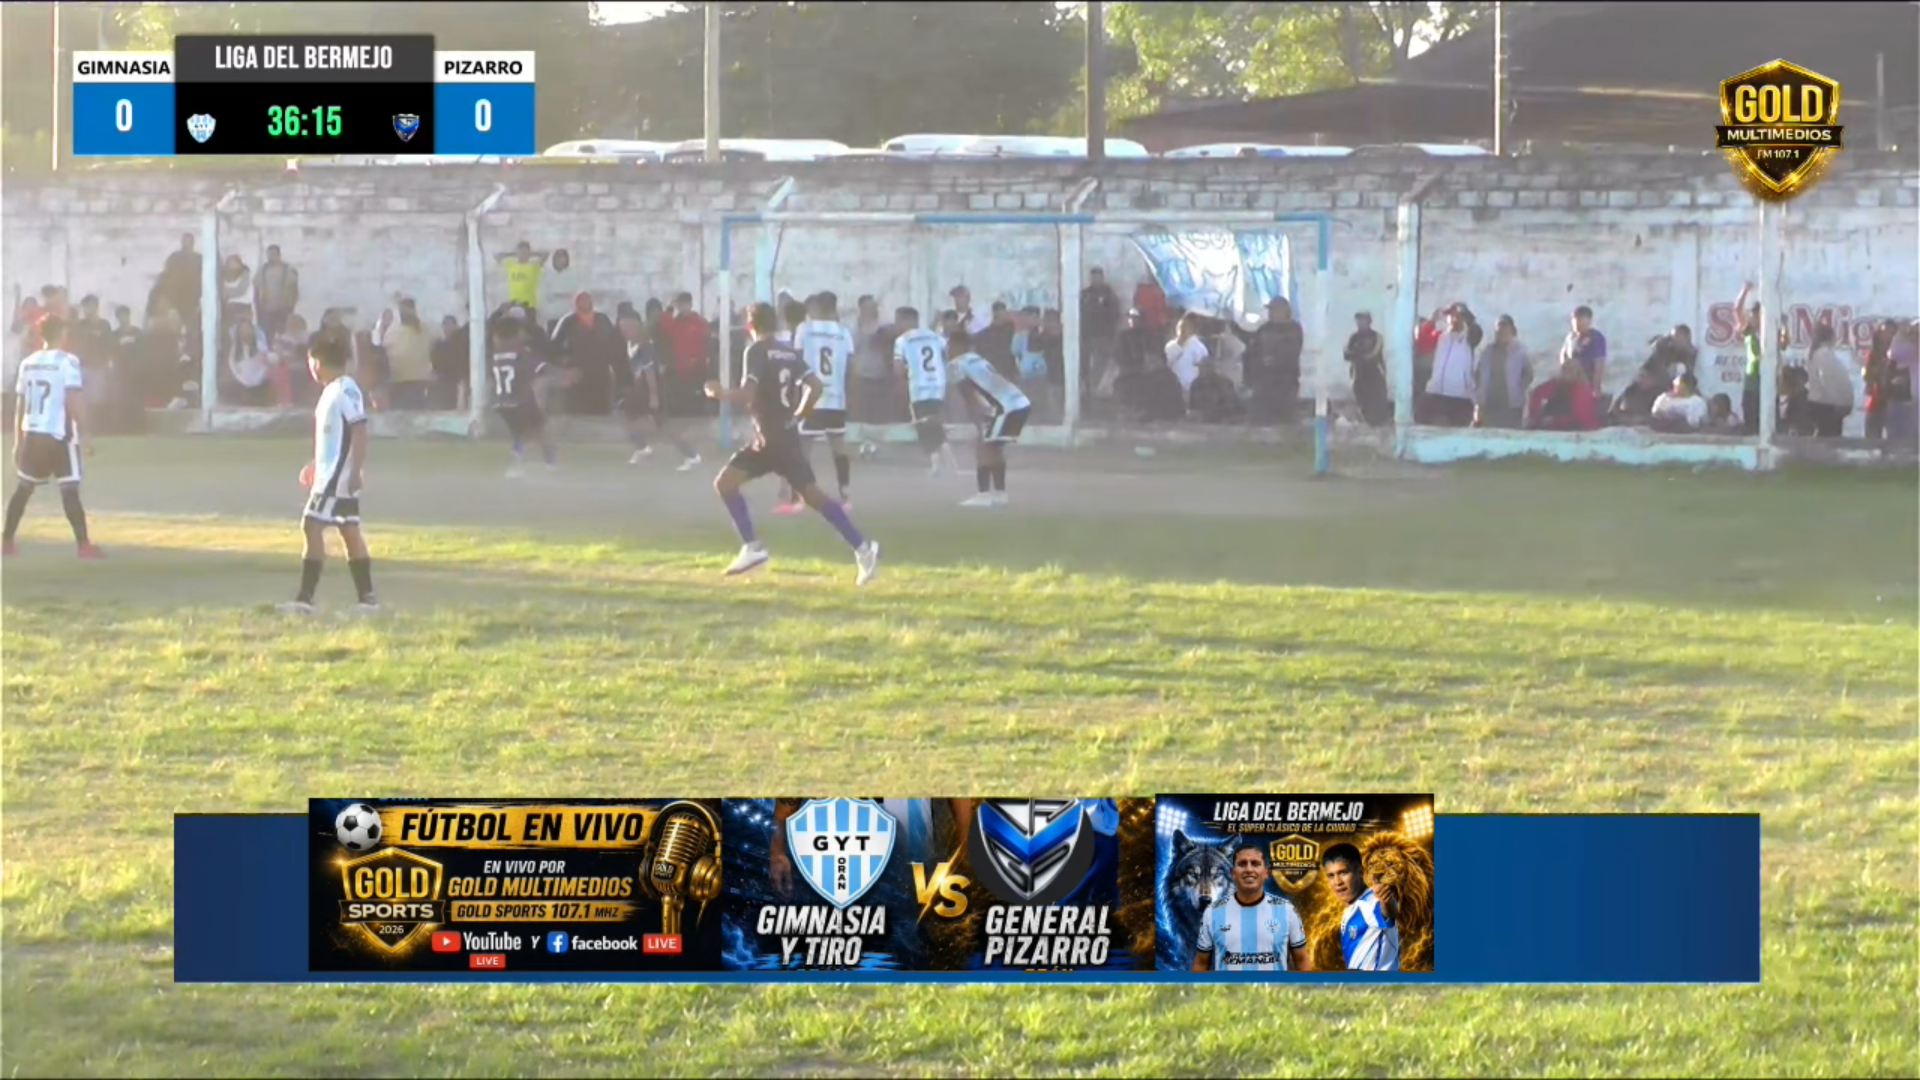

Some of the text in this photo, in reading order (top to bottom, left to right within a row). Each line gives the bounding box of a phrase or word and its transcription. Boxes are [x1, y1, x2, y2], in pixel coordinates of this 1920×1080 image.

[820, 346, 832, 375] 6
[921, 346, 936, 373] 2
[493, 365, 515, 395] 17
[27, 379, 51, 415] 17
